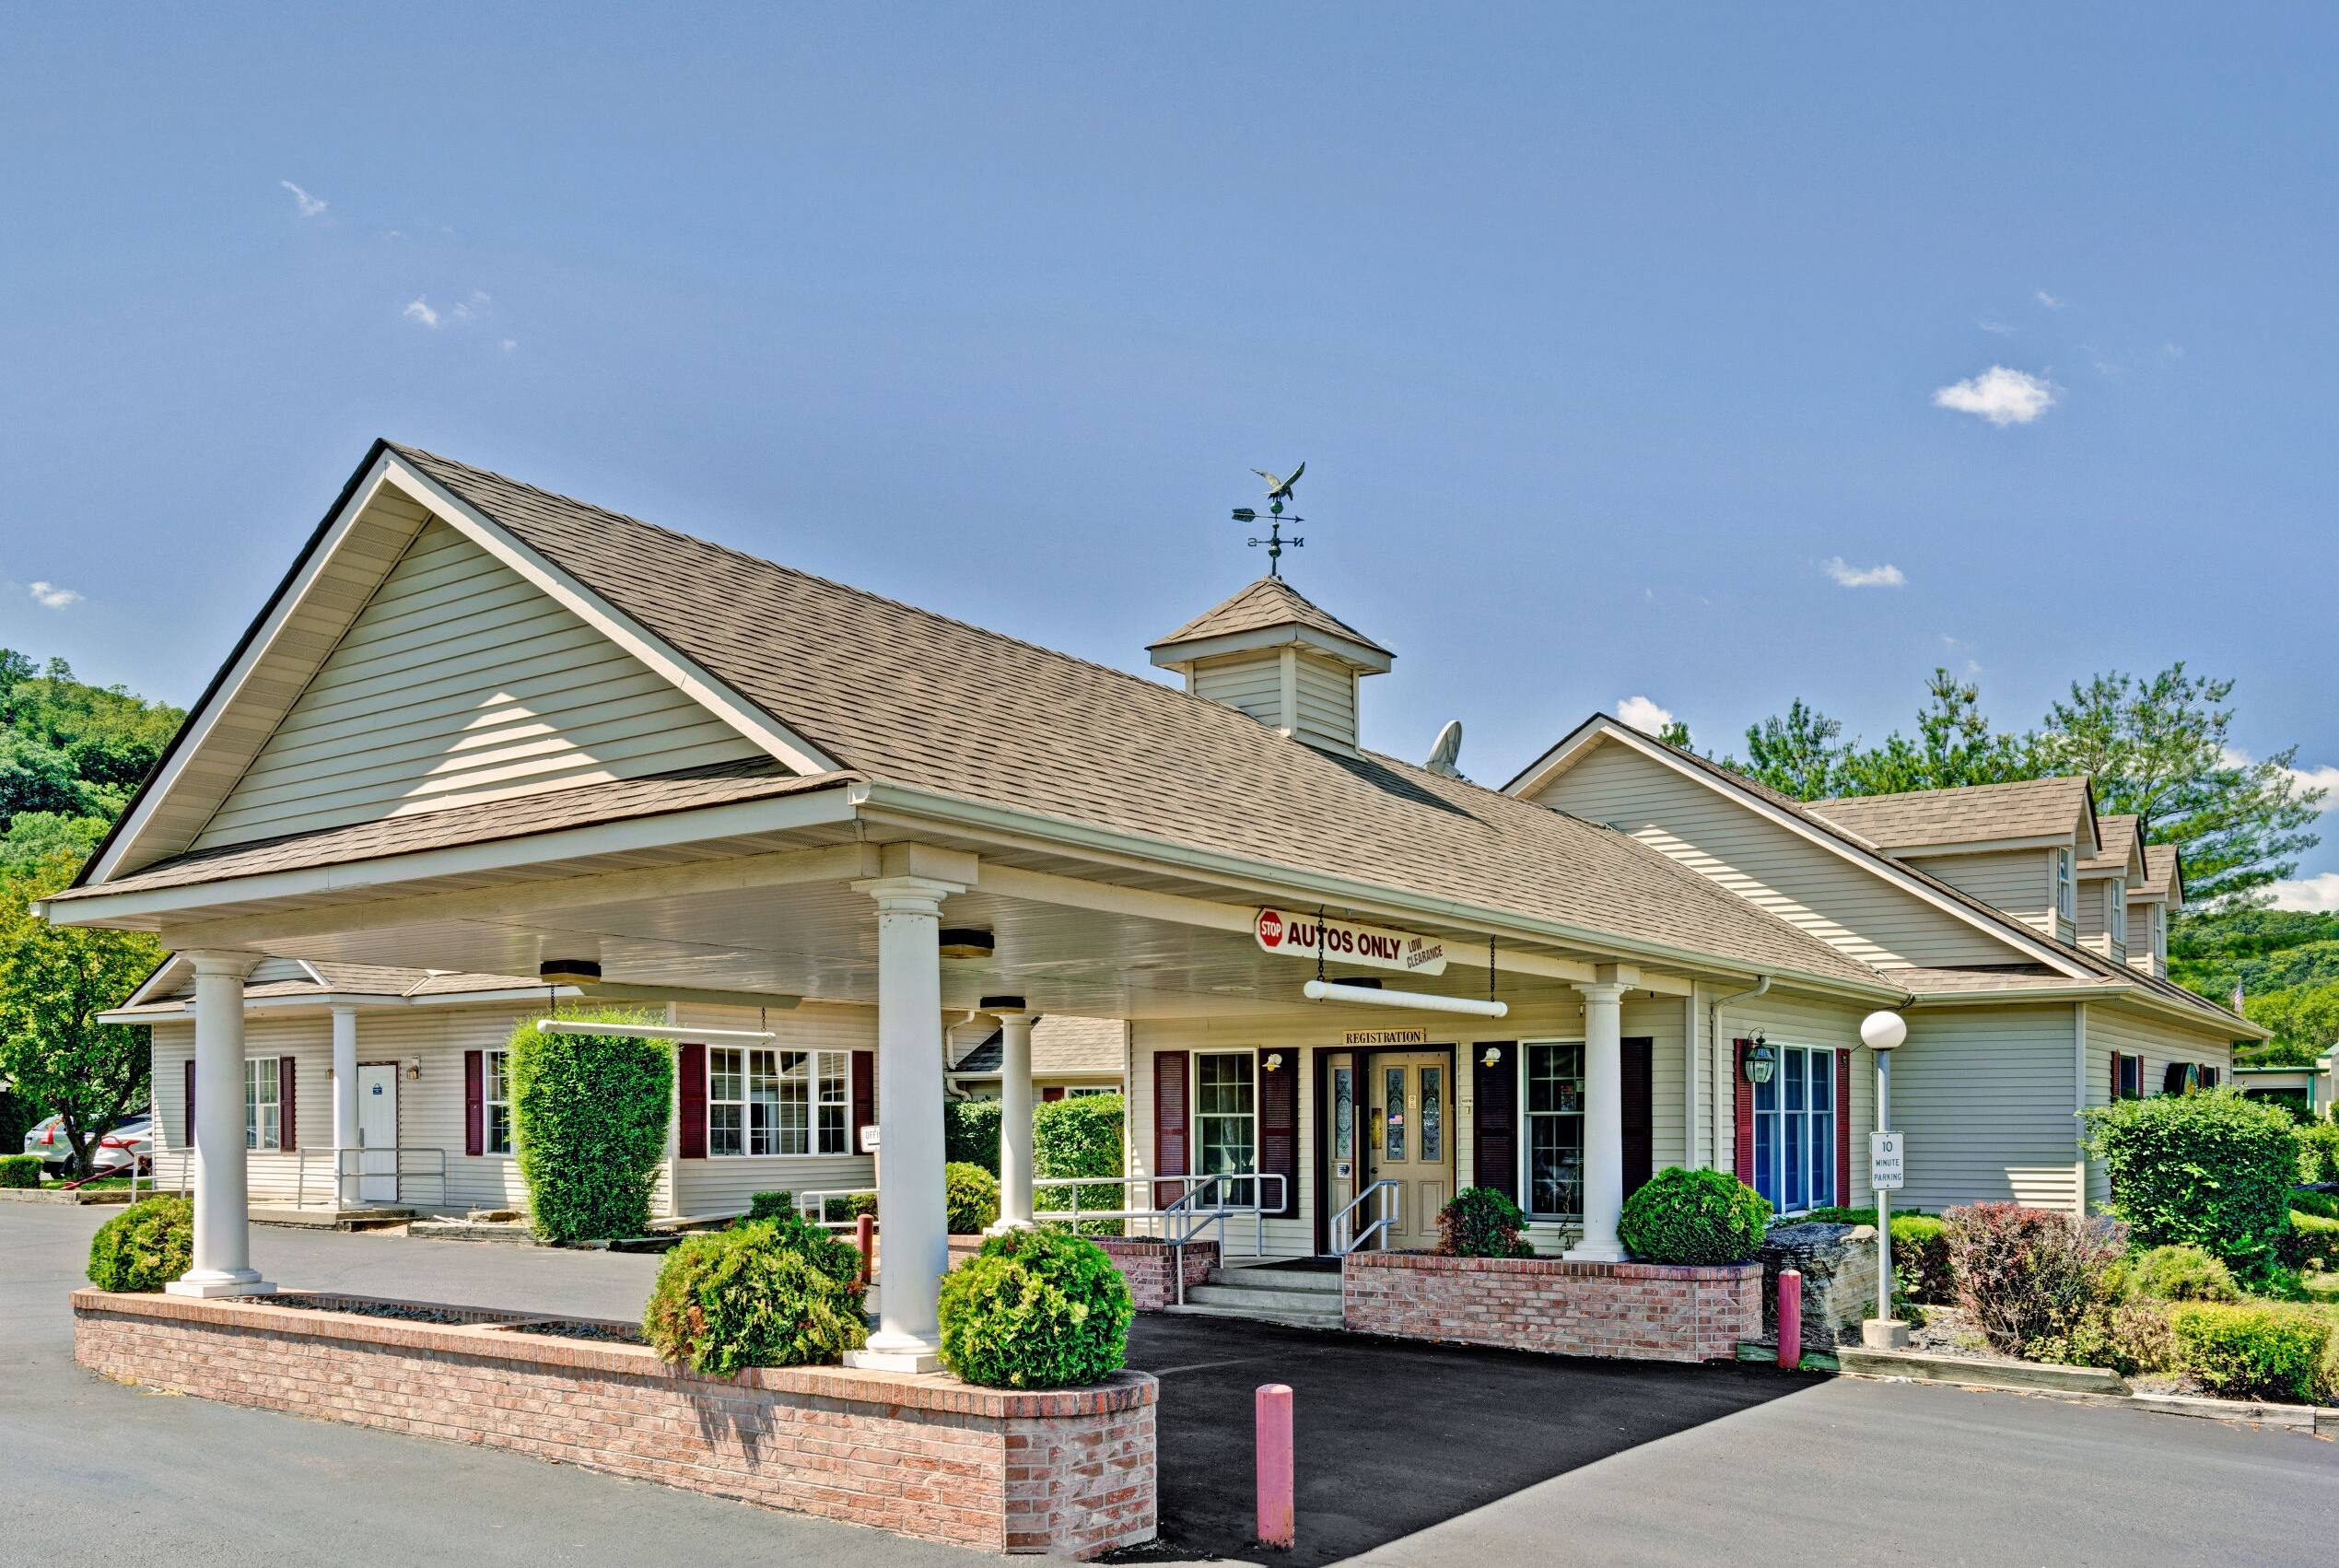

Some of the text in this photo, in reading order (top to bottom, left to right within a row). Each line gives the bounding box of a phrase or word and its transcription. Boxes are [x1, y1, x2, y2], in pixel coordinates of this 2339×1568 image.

[1261, 921, 1281, 938] STOP
[1288, 922, 1401, 960] AUTOS ONLY
[1408, 938, 1422, 954] LOW
[1407, 945, 1443, 968] CLEARANCE
[1346, 1031, 1421, 1044] REGISTRATION
[865, 1130, 880, 1139] OFFI
[1882, 1141, 1892, 1152] 10
[1874, 1173, 1901, 1181] PARKING
